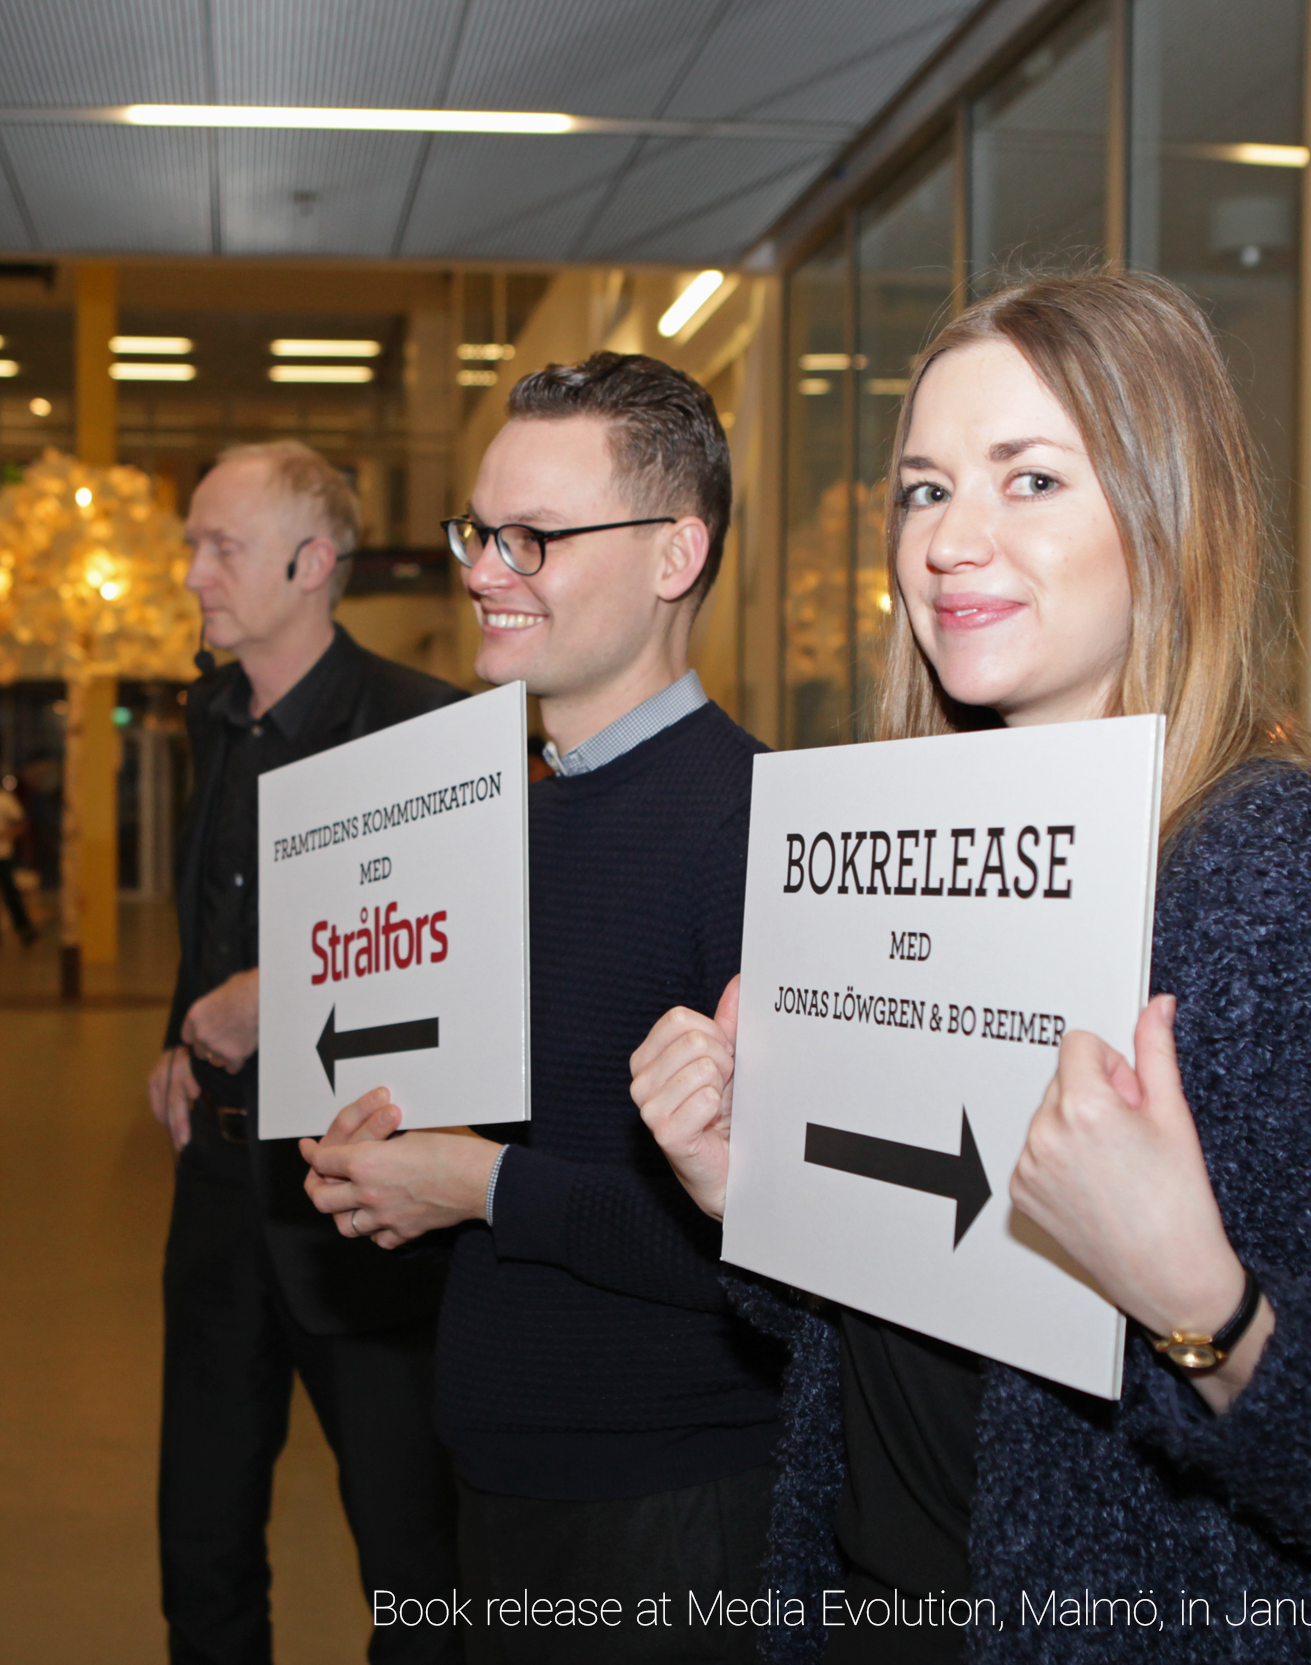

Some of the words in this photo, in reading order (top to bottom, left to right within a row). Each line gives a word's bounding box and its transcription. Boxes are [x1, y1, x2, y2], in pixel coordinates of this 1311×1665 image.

[274, 817, 359, 862] FRAMTIDENS
[362, 772, 502, 836] KOMMUNIKATION
[359, 856, 392, 885] MED
[783, 825, 1076, 899] BOKRELEASE
[311, 901, 448, 985] Strålfors
[889, 931, 931, 961] MED
[774, 986, 829, 1017] JONAS
[833, 986, 926, 1030] LÖWGREN
[929, 1003, 944, 1032] &
[947, 1004, 976, 1036] BO
[980, 1007, 1066, 1047] REIMER
